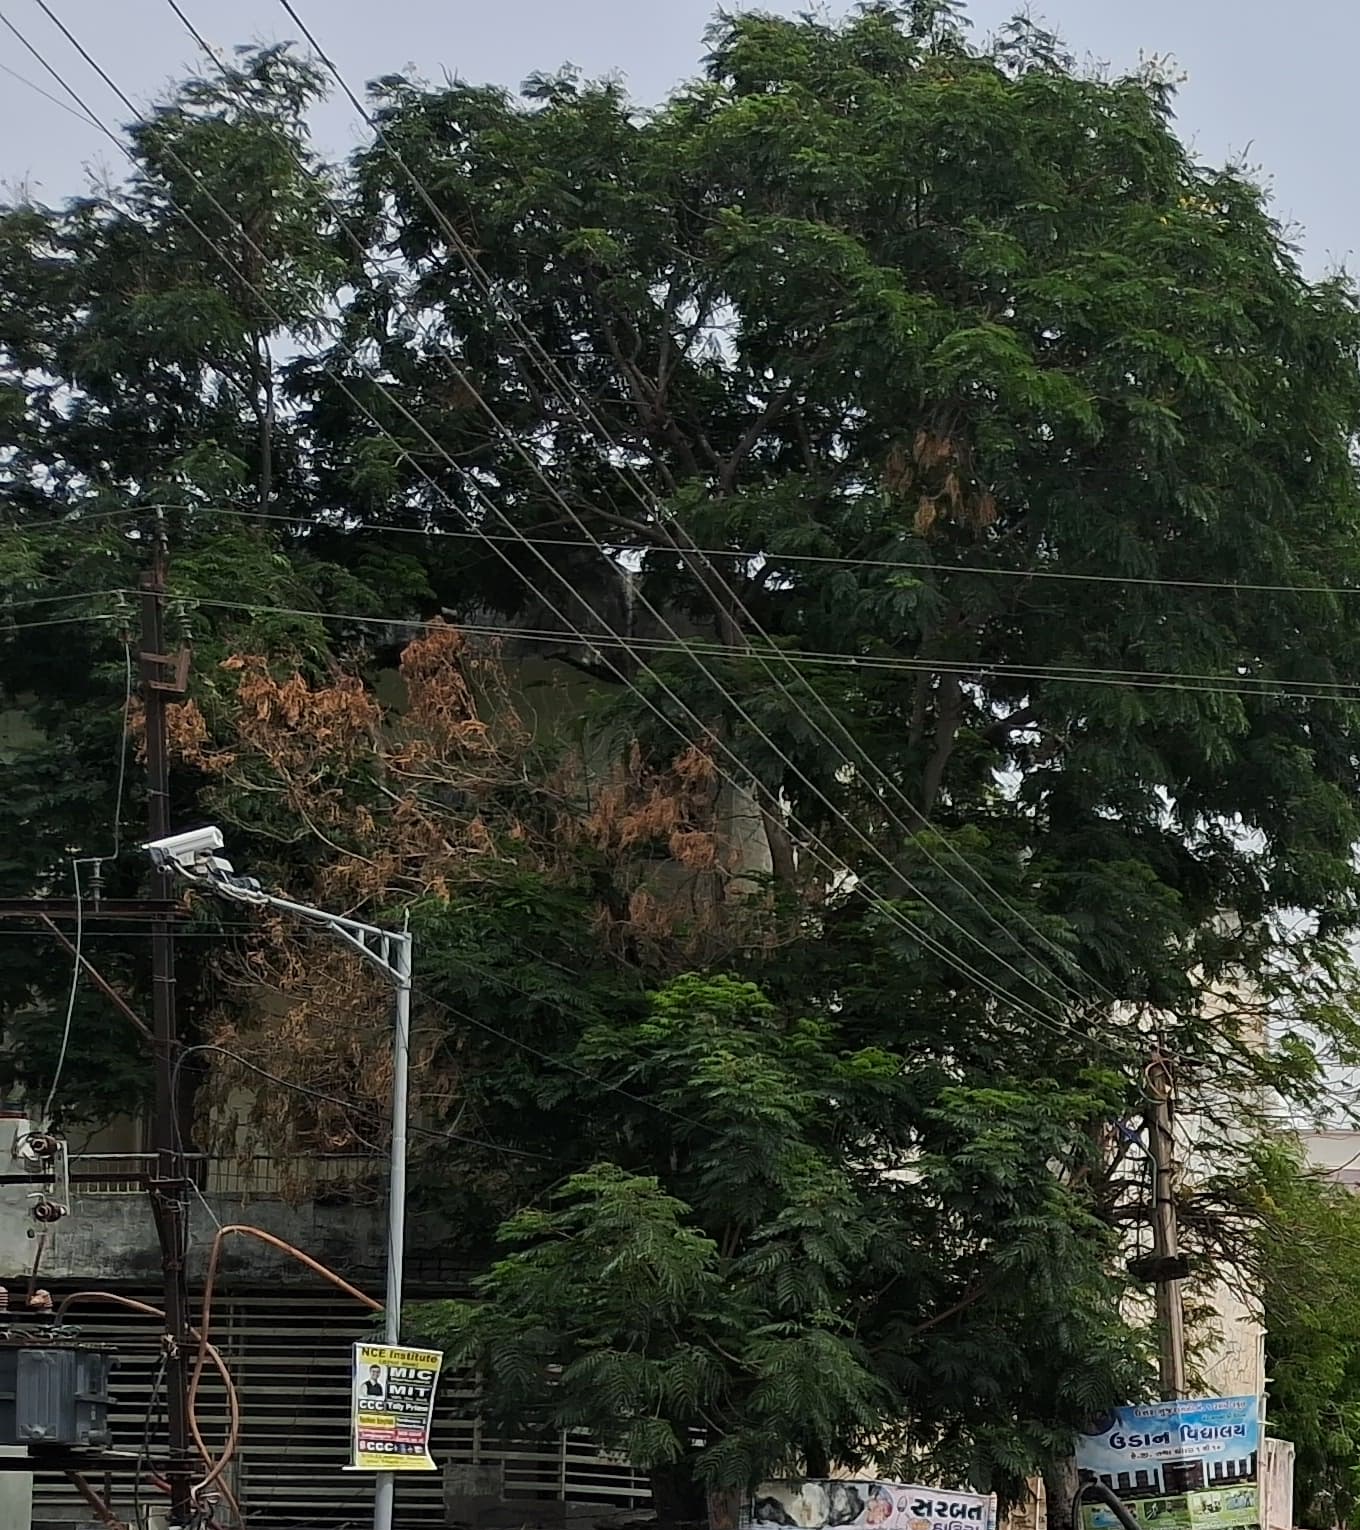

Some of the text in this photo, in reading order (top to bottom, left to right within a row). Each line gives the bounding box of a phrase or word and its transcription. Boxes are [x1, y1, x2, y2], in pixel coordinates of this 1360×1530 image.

[361, 1347, 438, 1364] NCE Institute
[389, 1366, 433, 1381] MIC
[389, 1384, 430, 1398] MIT
[359, 1399, 385, 1411] CCC
[1109, 1423, 1246, 1450] ઉડાન વિદ્યાલય
[910, 1498, 983, 1521] સરબત
